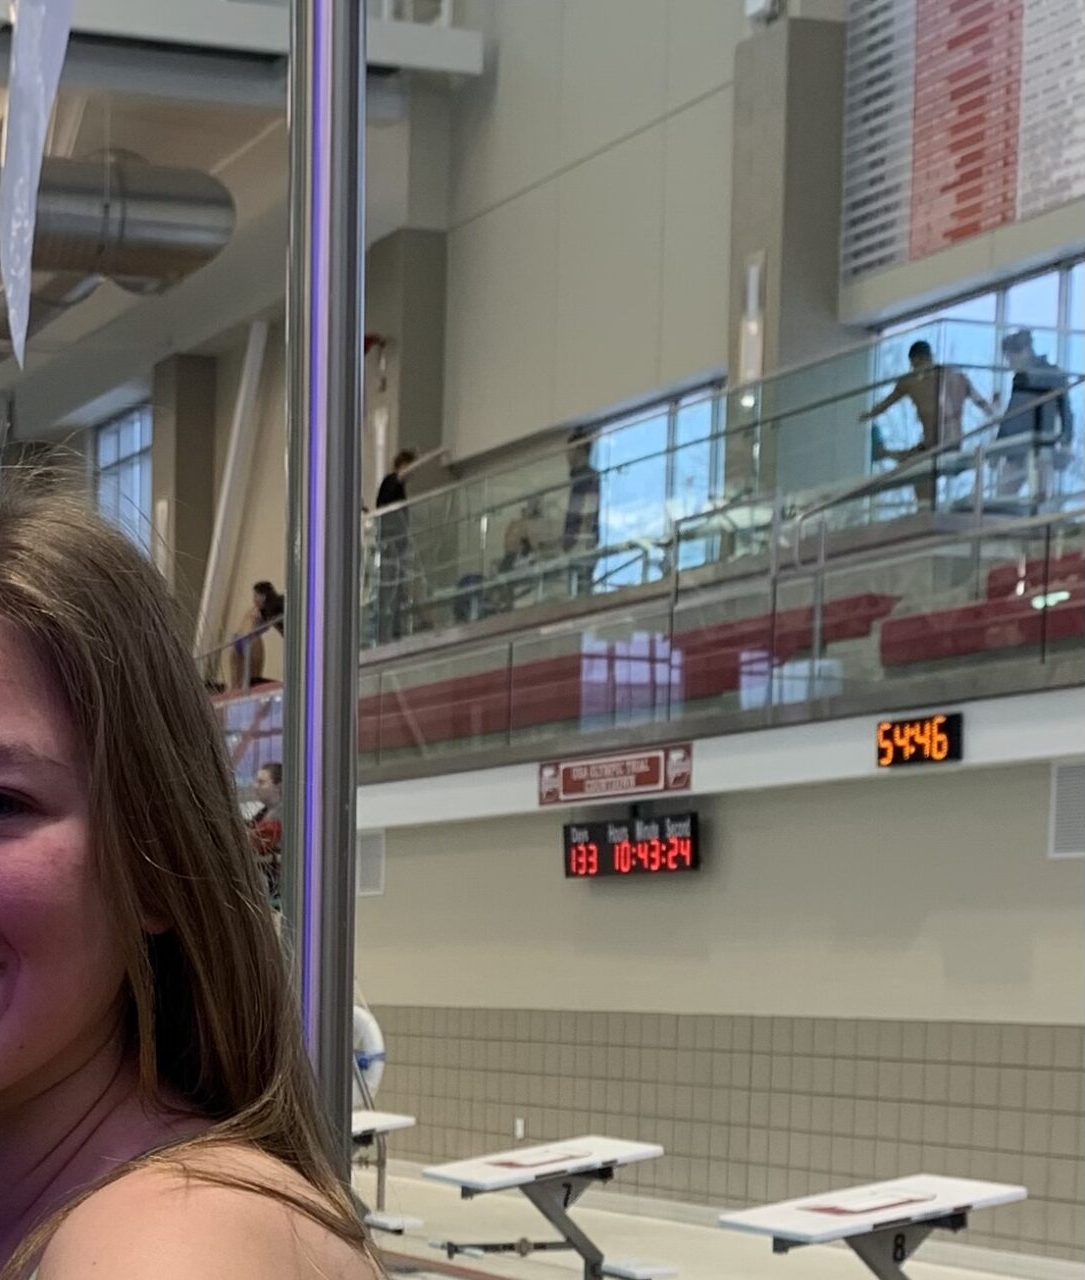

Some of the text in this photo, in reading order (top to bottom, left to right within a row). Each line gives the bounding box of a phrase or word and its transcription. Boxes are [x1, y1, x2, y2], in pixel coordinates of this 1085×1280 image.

[877, 713, 947, 767] 54:46
[571, 837, 691, 875] 133 10:43:24
[562, 1183, 572, 1209] 7
[893, 1233, 906, 1262] 8
